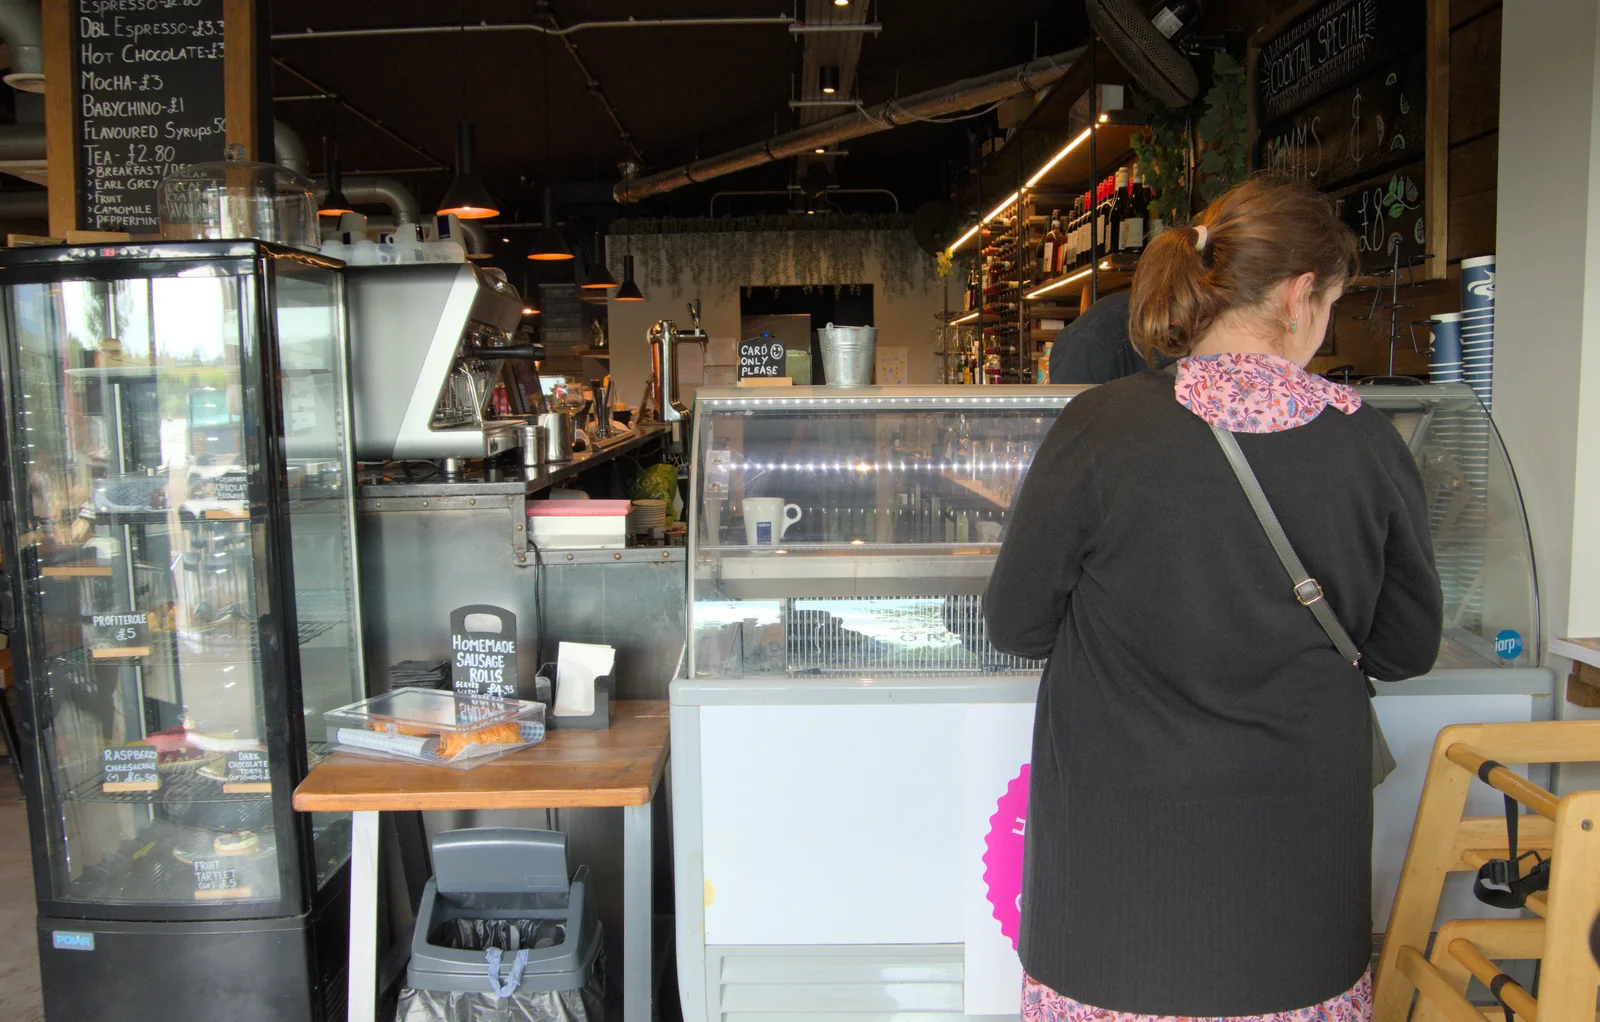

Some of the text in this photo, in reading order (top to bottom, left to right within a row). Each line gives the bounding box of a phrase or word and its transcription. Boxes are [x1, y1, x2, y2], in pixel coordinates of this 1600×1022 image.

[80, 16, 110, 38] DBL
[81, 43, 114, 64] HOT
[1269, 2, 1366, 95] COCKTAIL SPECIAL
[83, 120, 159, 140] FLAVOURED
[126, 143, 176, 167] £2.80
[95, 179, 159, 190] EARL GREY
[94, 191, 123, 204] FRUIT
[93, 205, 152, 214] CAMOMILE
[96, 214, 160, 228] PEPPERMIN
[741, 344, 768, 356] CARD
[741, 356, 769, 366] ONLY
[741, 365, 779, 377] PLEASE
[93, 613, 147, 627] PROFITEROLE
[116, 627, 136, 641] £5
[452, 634, 516, 654] HOMEMADE
[456, 652, 505, 668] SAUSAGE
[469, 668, 503, 683] ROLLS
[455, 680, 480, 689] SERVED
[238, 752, 261, 761] DARK
[194, 860, 220, 871] FRUIT
[194, 869, 237, 882] TARTLET
